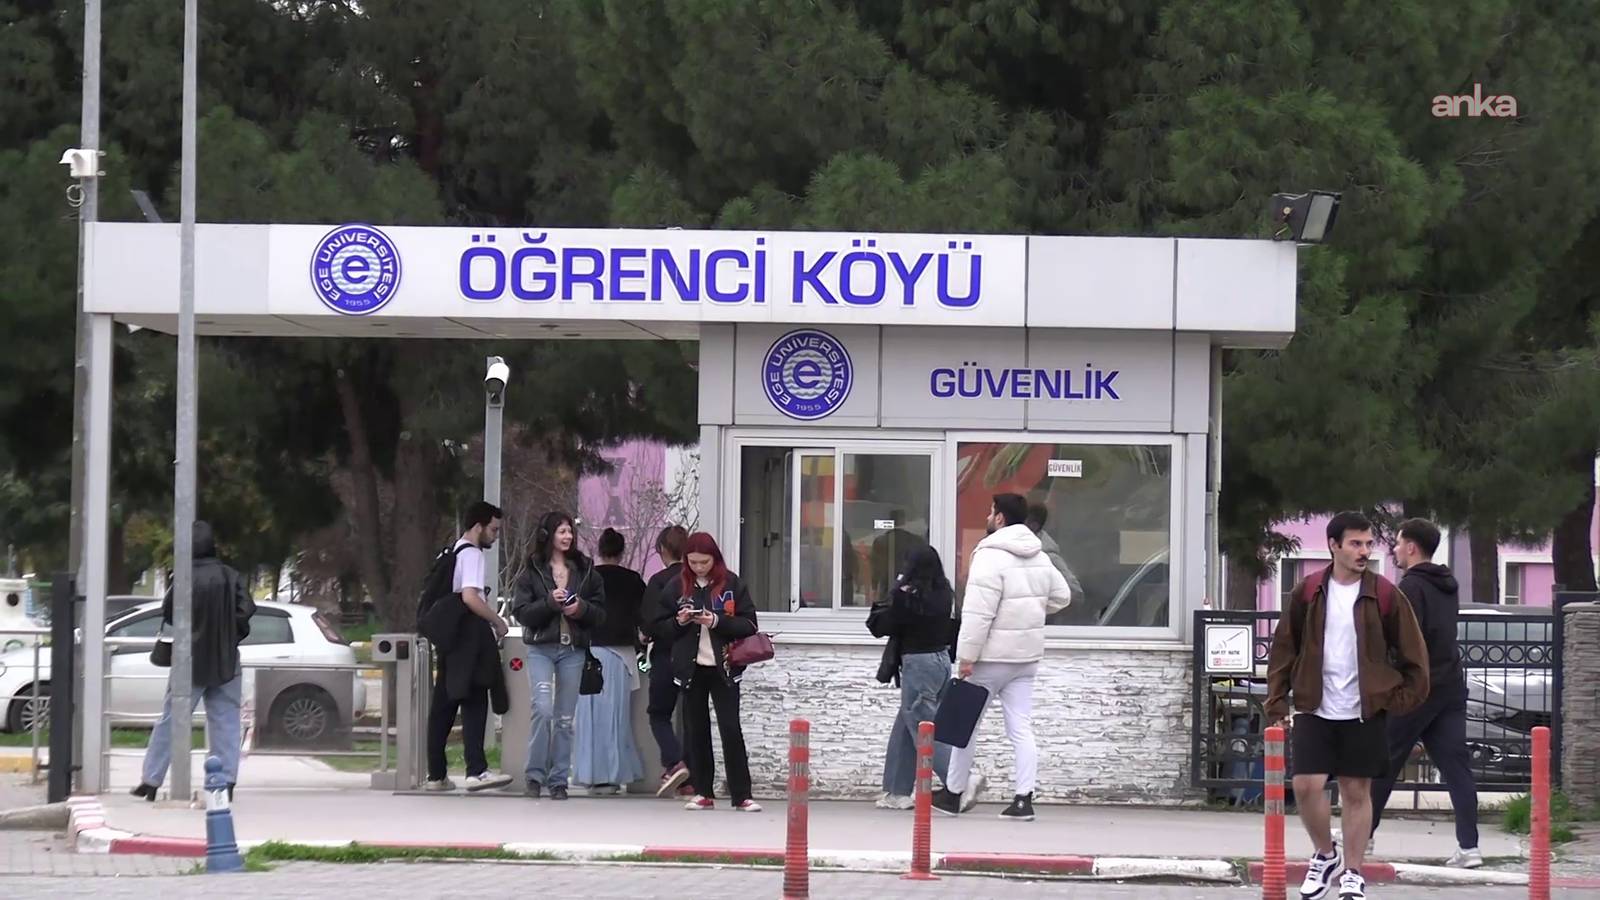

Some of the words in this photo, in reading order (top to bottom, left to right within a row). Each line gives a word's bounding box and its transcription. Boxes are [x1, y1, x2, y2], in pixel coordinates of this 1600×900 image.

[318, 268, 341, 301] EGE
[460, 233, 766, 302] ÖĞRENCİ
[792, 239, 982, 307] KÖYÜ
[344, 299, 371, 307] 1955
[770, 372, 792, 405] EGE
[930, 361, 1120, 400] GÜVENLİK
